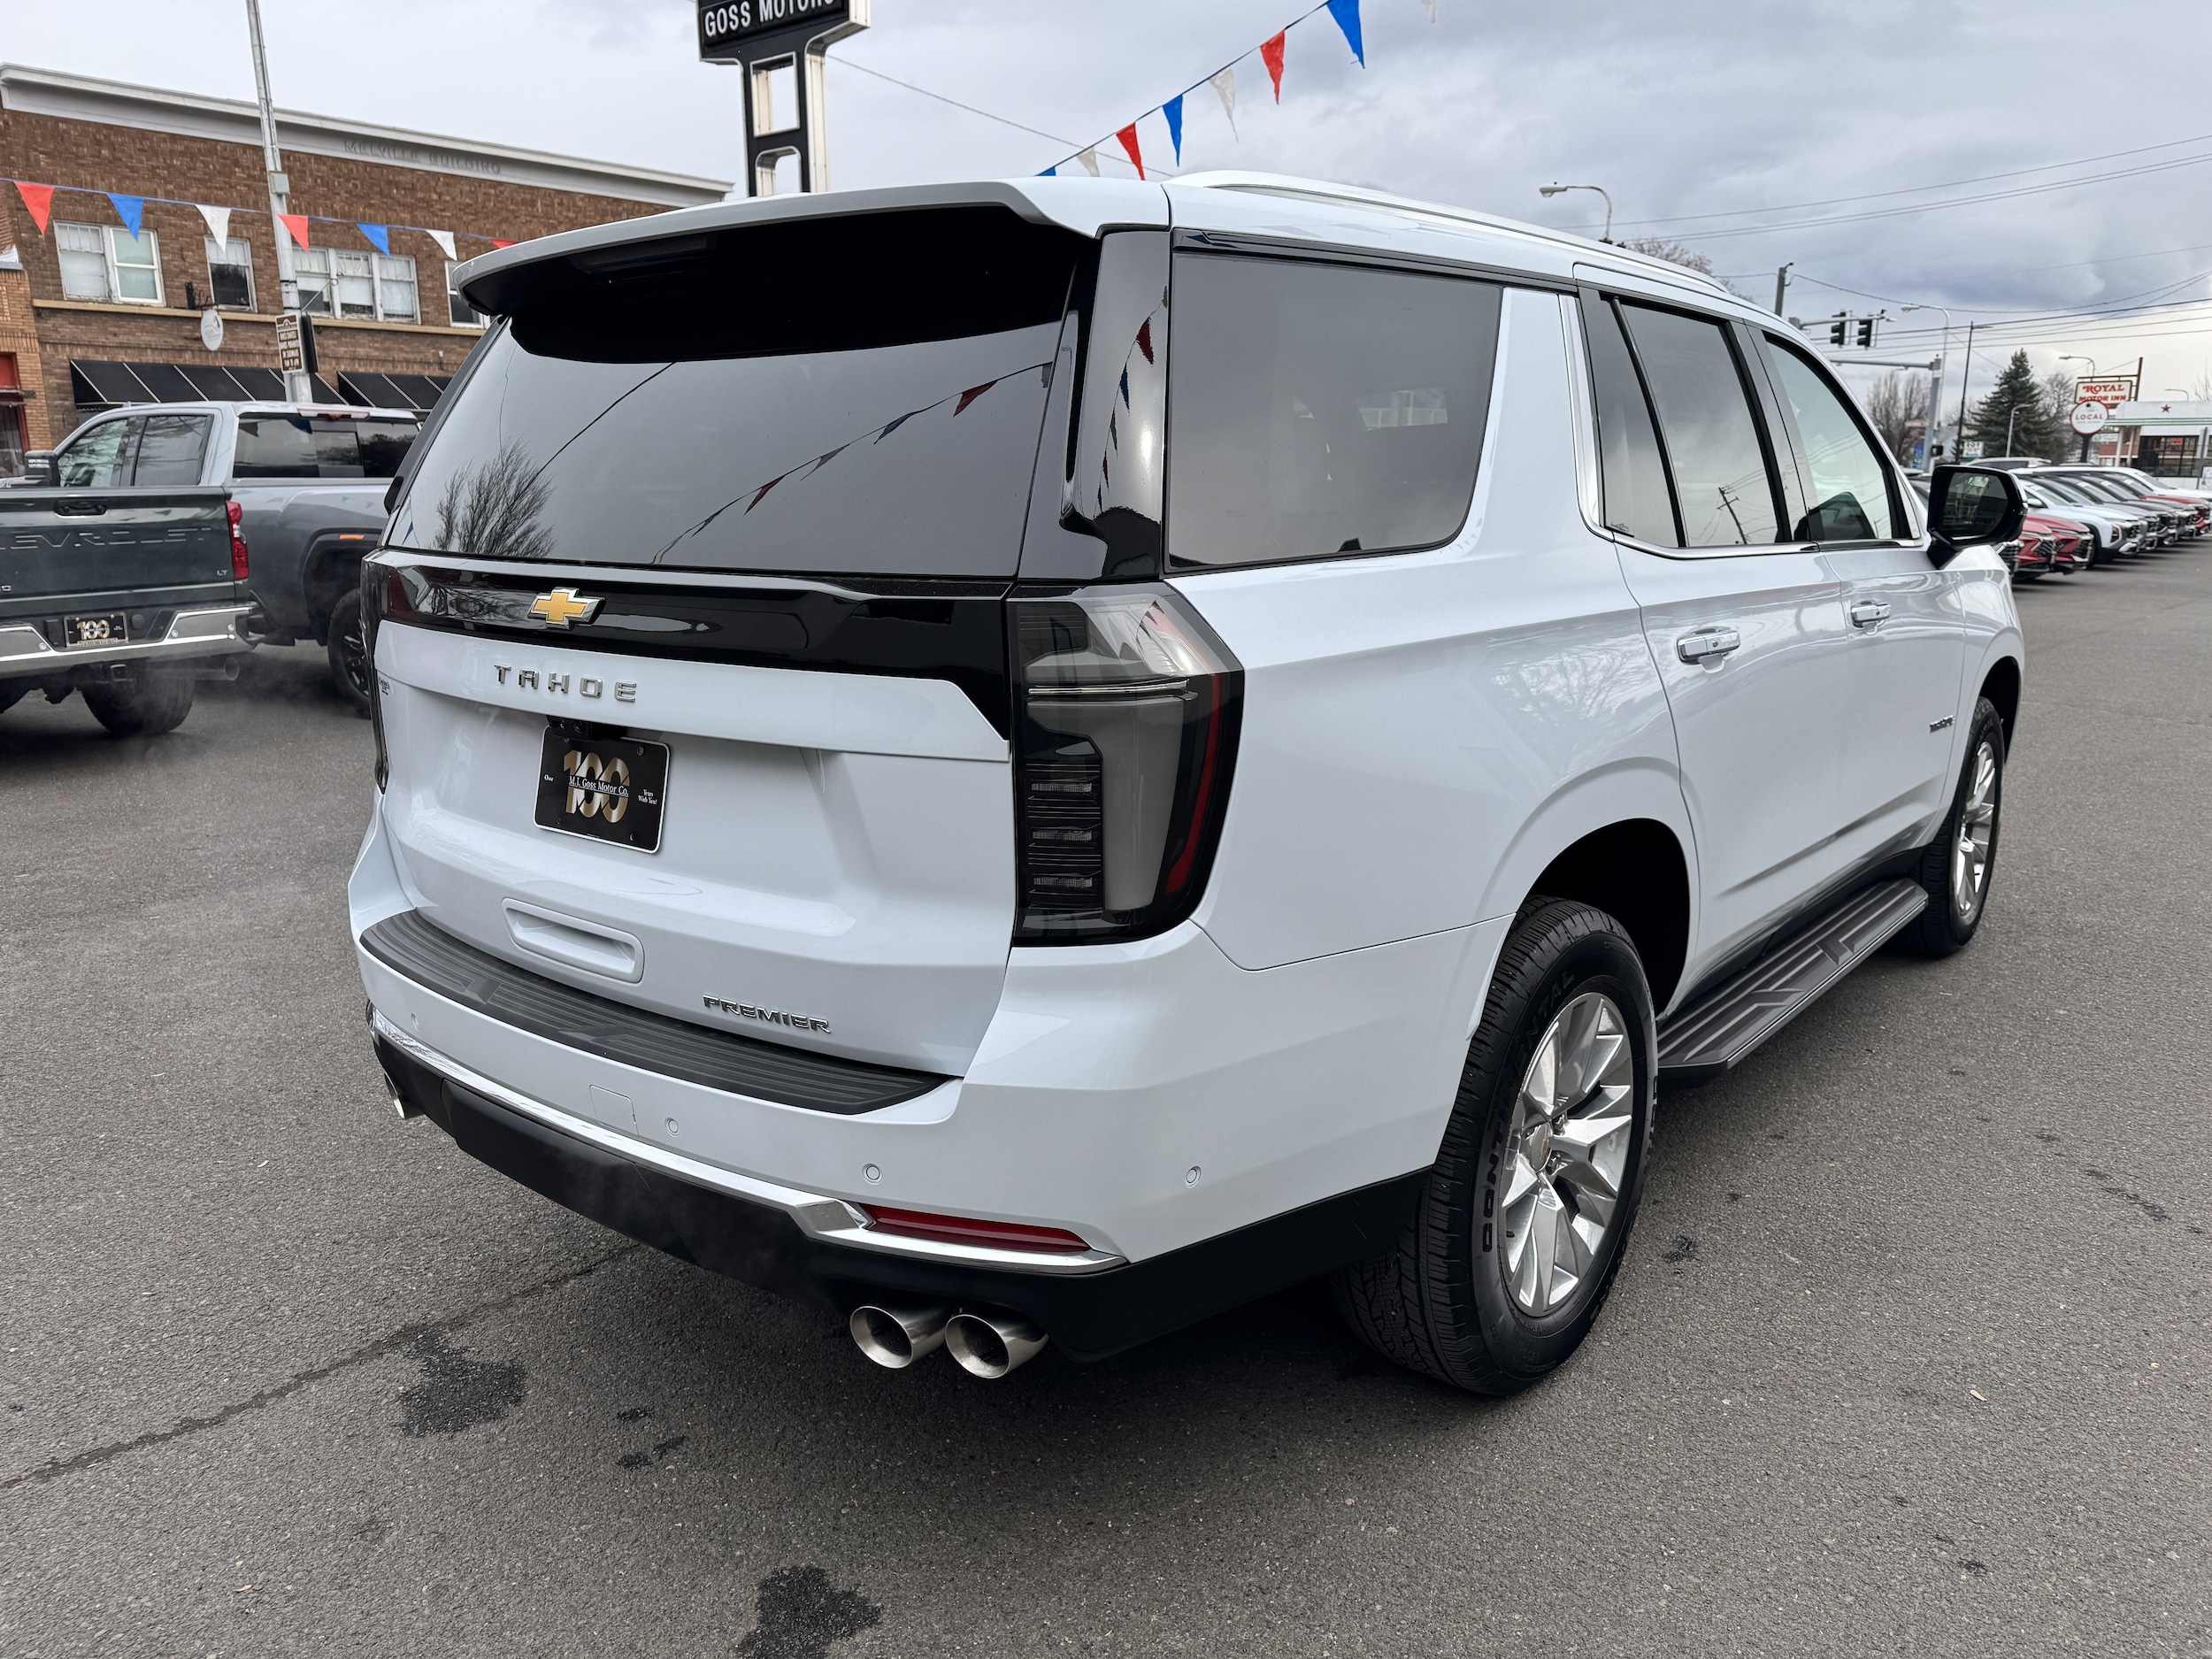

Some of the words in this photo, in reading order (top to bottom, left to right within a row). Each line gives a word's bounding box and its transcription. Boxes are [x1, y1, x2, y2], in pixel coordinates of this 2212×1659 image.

[704, 1, 751, 37] GOSS
[759, 0, 834, 22] MOT
[344, 140, 419, 163] MELVILLE
[429, 152, 501, 175] BUILDING
[2082, 384, 2125, 395] ROYAL
[76, 619, 111, 641] 100
[494, 664, 637, 703] TAHOE
[563, 749, 631, 824] 100
[581, 778, 597, 790] Goss
[598, 781, 618, 794] Motor
[618, 785, 629, 796] Co.
[702, 994, 832, 1034] PREMIER
